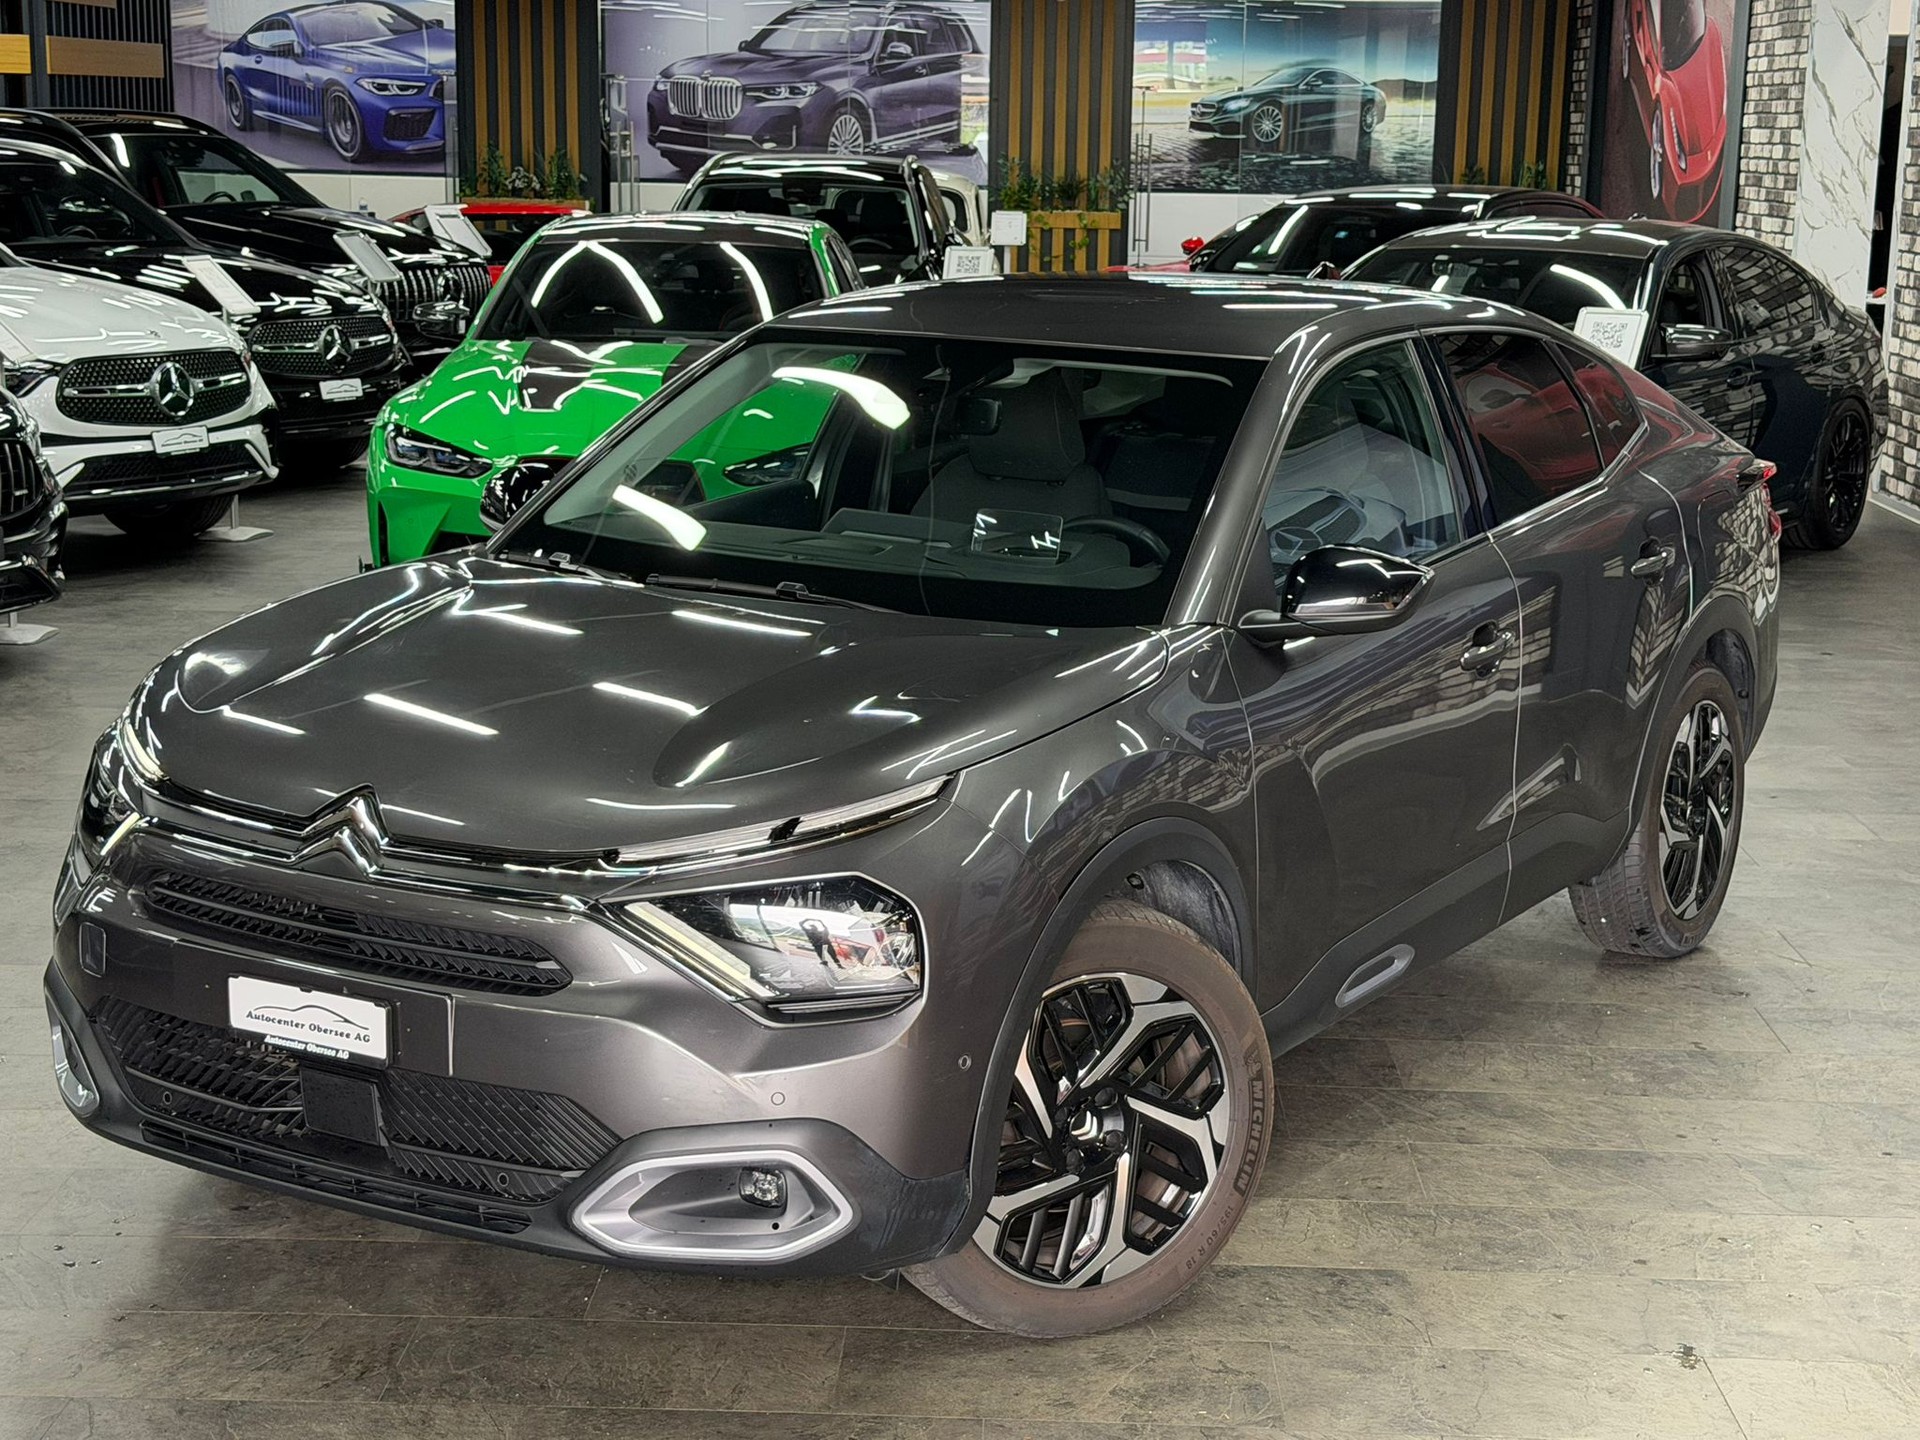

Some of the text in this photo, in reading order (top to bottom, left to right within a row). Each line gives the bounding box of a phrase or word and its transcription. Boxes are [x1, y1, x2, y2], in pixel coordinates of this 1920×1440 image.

[246, 1010, 371, 1043] Autocenter Obersee AG
[264, 1035, 350, 1060] Autocenter Obersee AG
[1237, 1080, 1264, 1191] MICHELIN
[1186, 1205, 1234, 1270] 195/60 R 18
